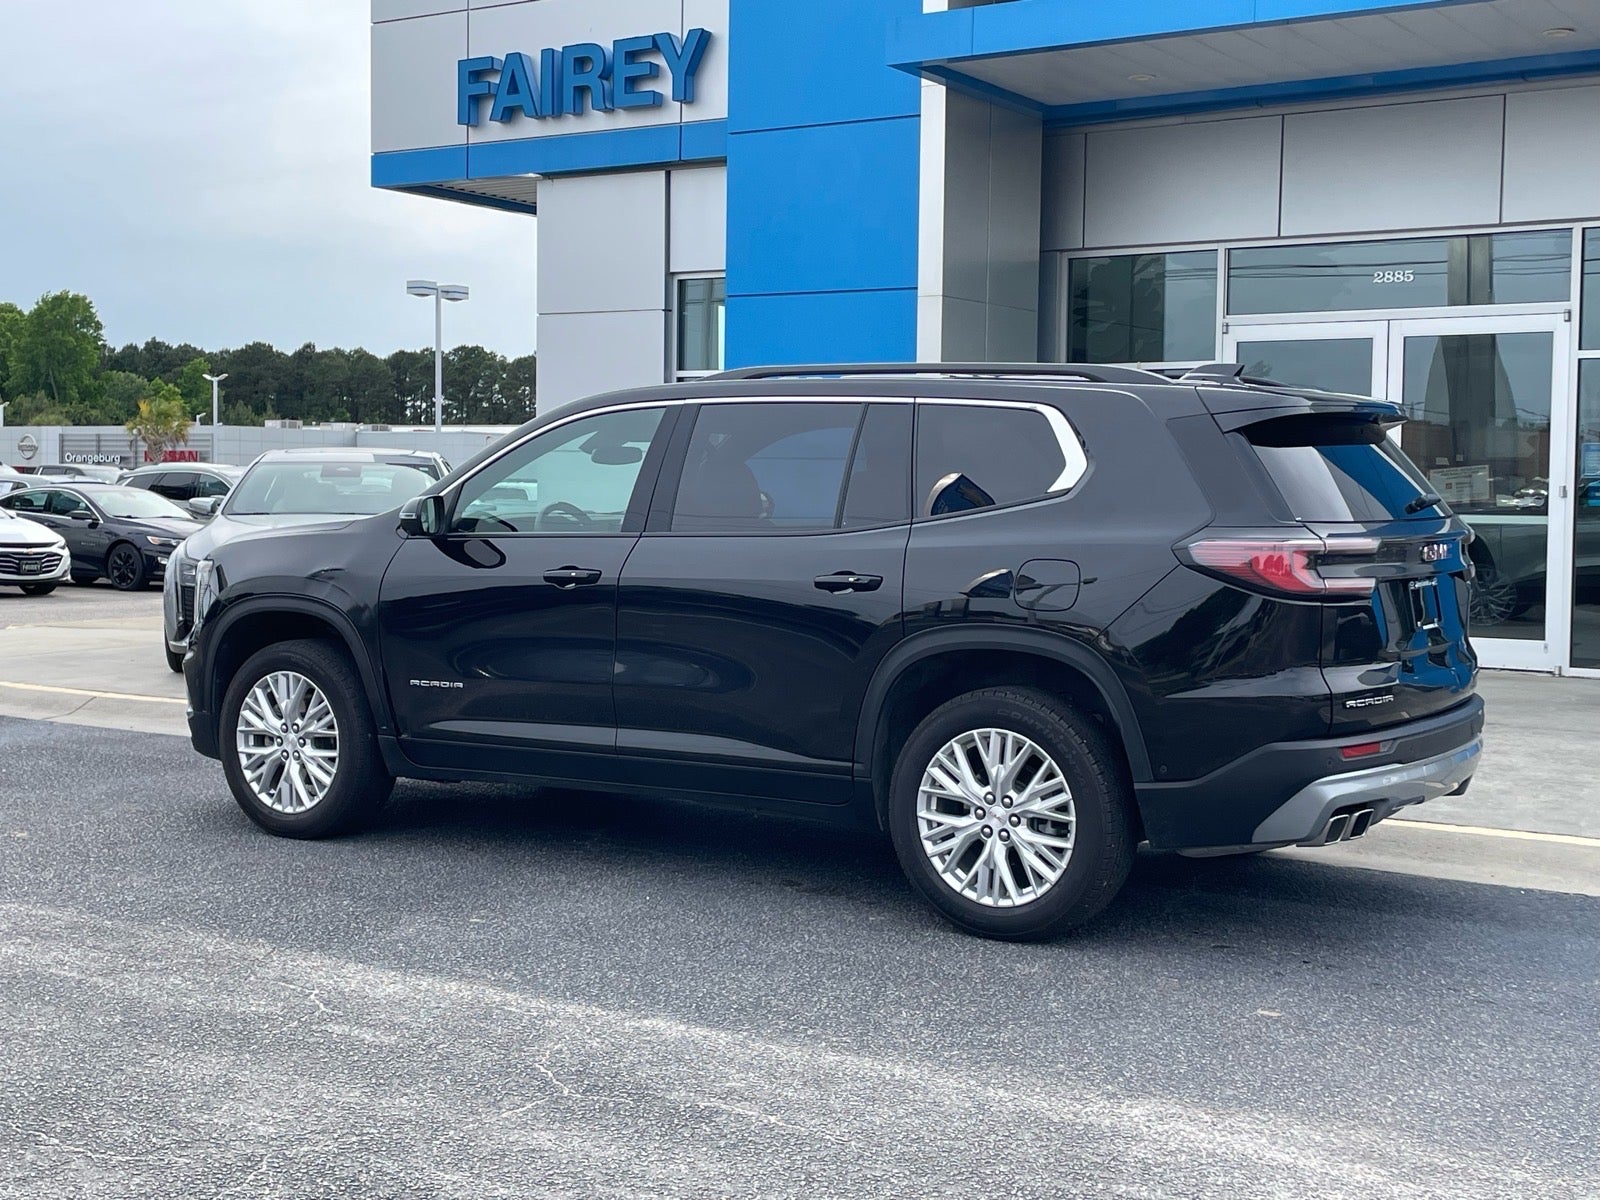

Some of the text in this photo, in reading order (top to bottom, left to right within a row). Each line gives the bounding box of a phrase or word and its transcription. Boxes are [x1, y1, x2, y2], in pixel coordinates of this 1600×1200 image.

[457, 28, 712, 126] FAIREY
[1372, 270, 1414, 283] 2885
[64, 452, 121, 464] Orangeburg
[143, 450, 198, 462] NSSAN
[409, 679, 464, 689] ACADIA
[1345, 694, 1394, 708] ACADIA
